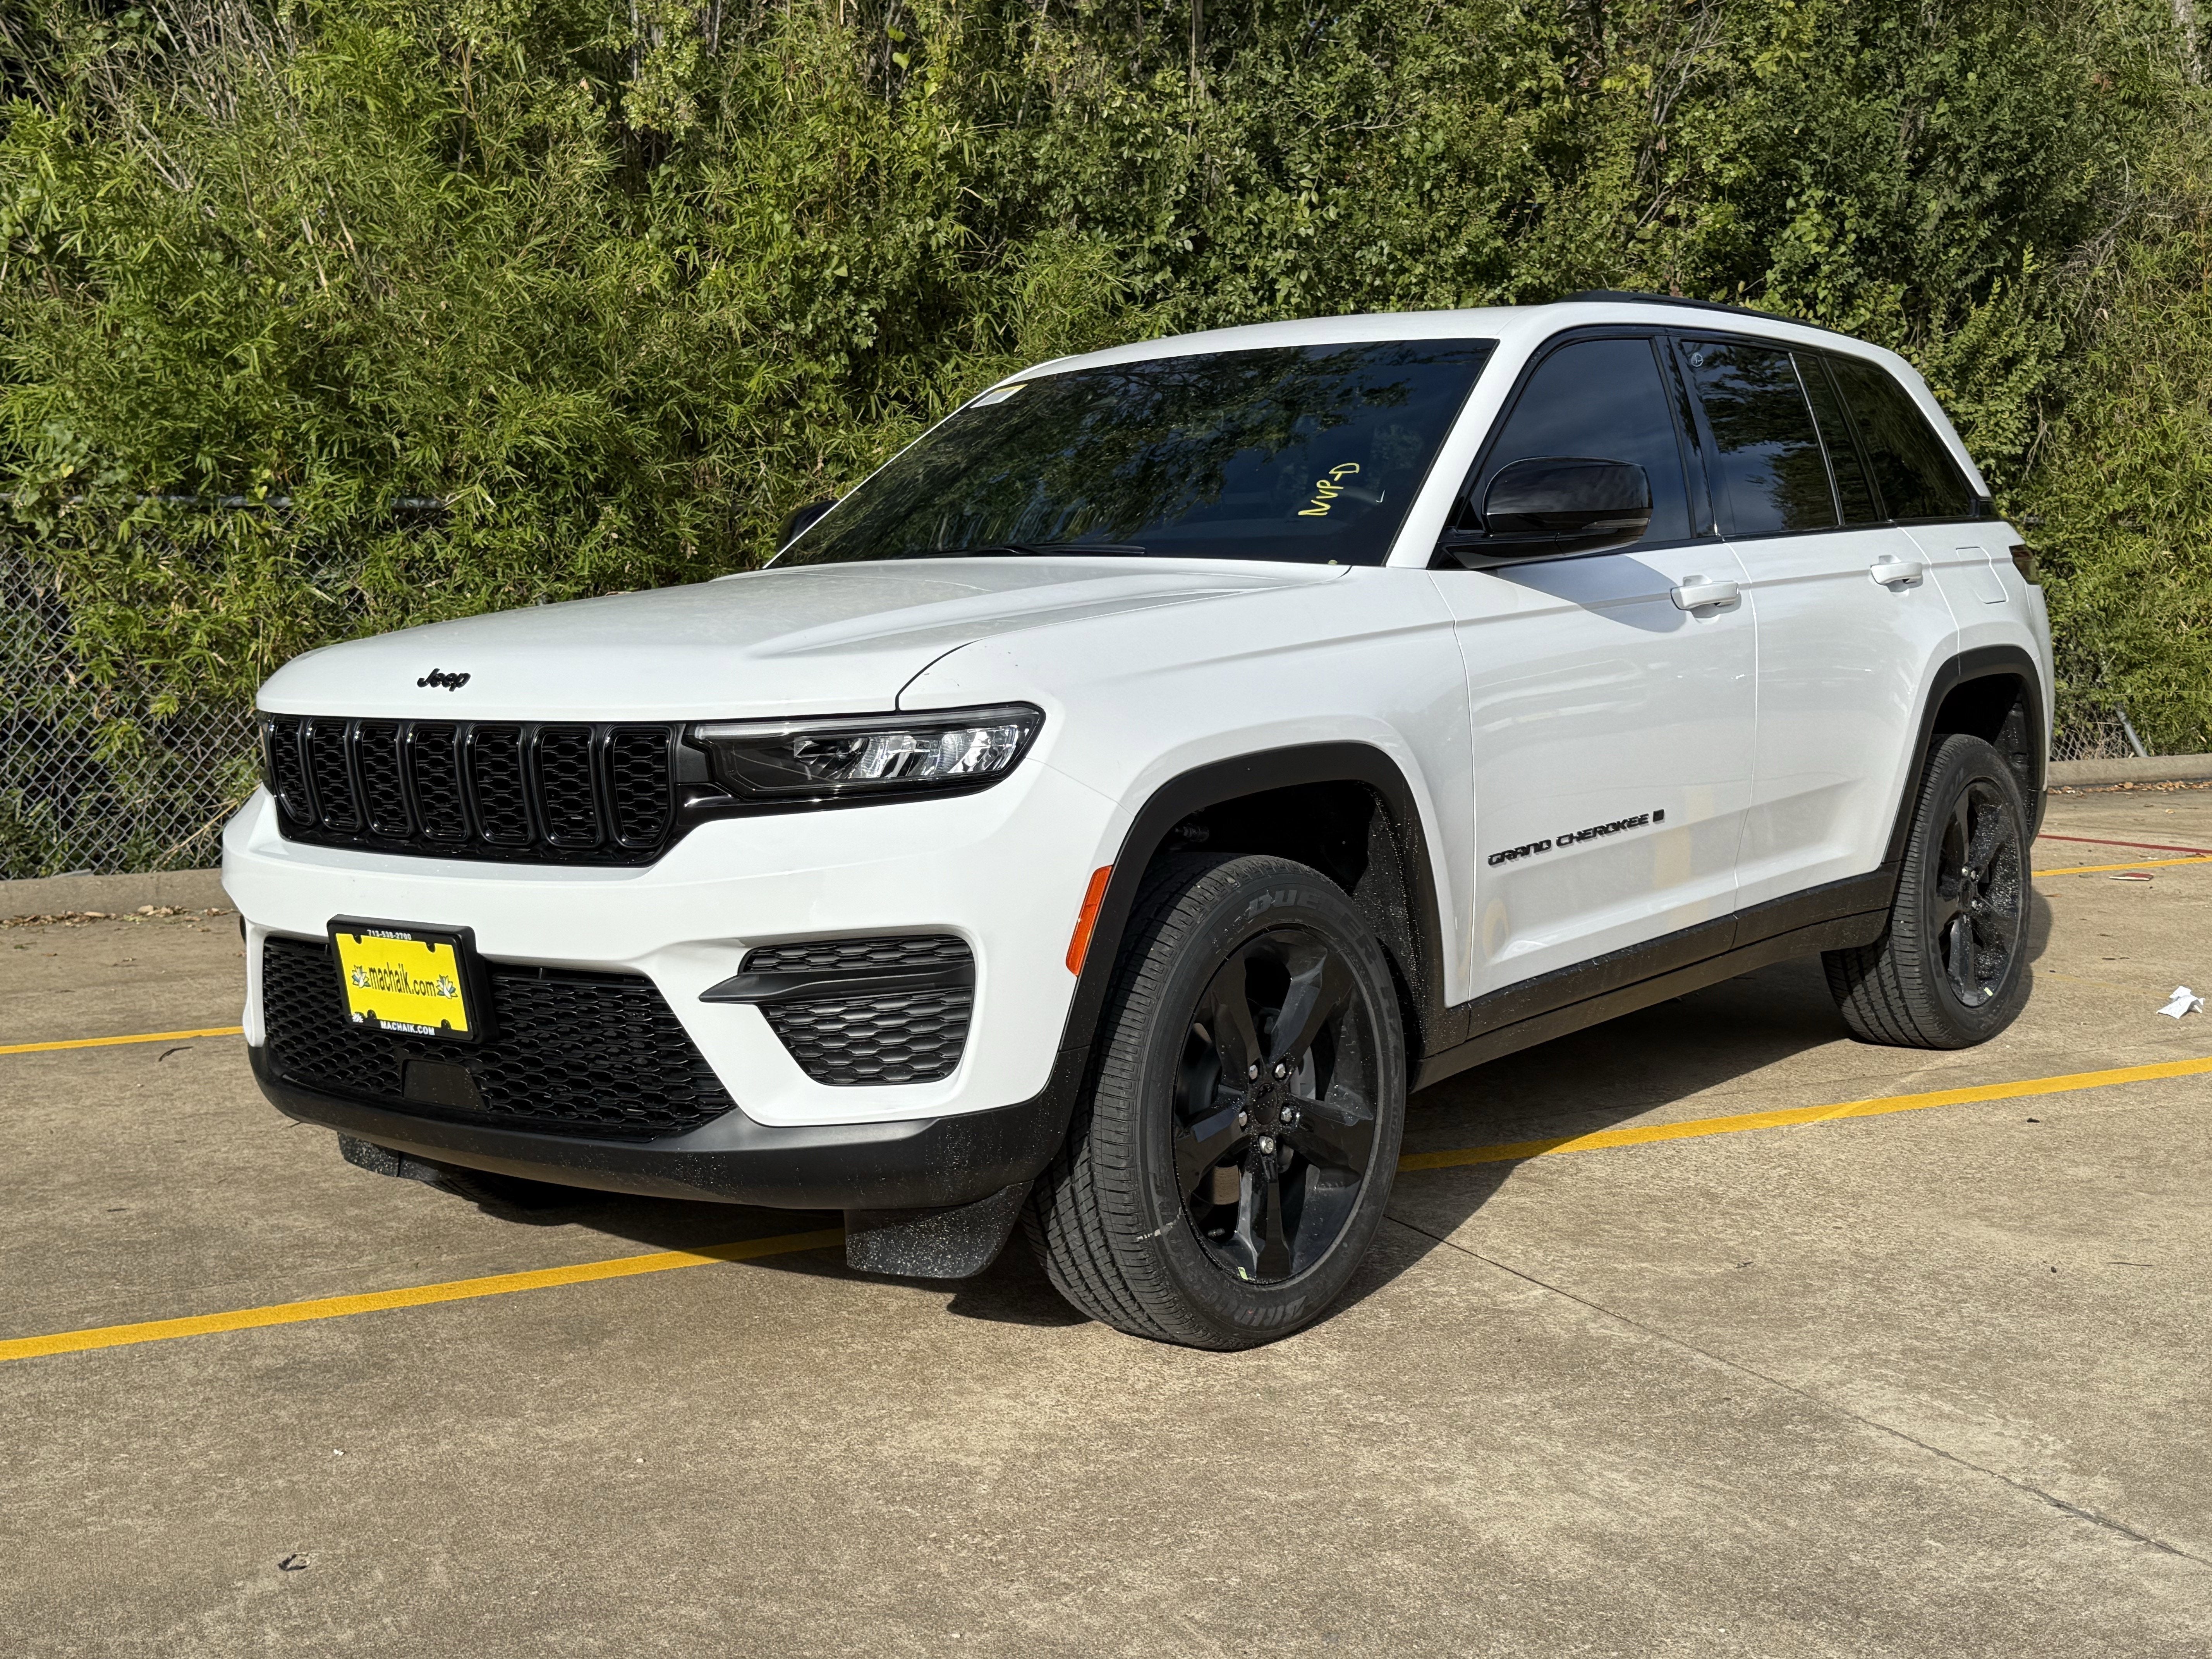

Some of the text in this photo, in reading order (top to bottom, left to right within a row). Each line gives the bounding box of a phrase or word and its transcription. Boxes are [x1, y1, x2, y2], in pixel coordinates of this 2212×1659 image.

[417, 668, 471, 692] Jeep
[1488, 813, 1649, 866] GRAND CHEROKEE
[368, 962, 436, 997] machaik.com
[380, 1020, 435, 1036] MACHAIK.COM
